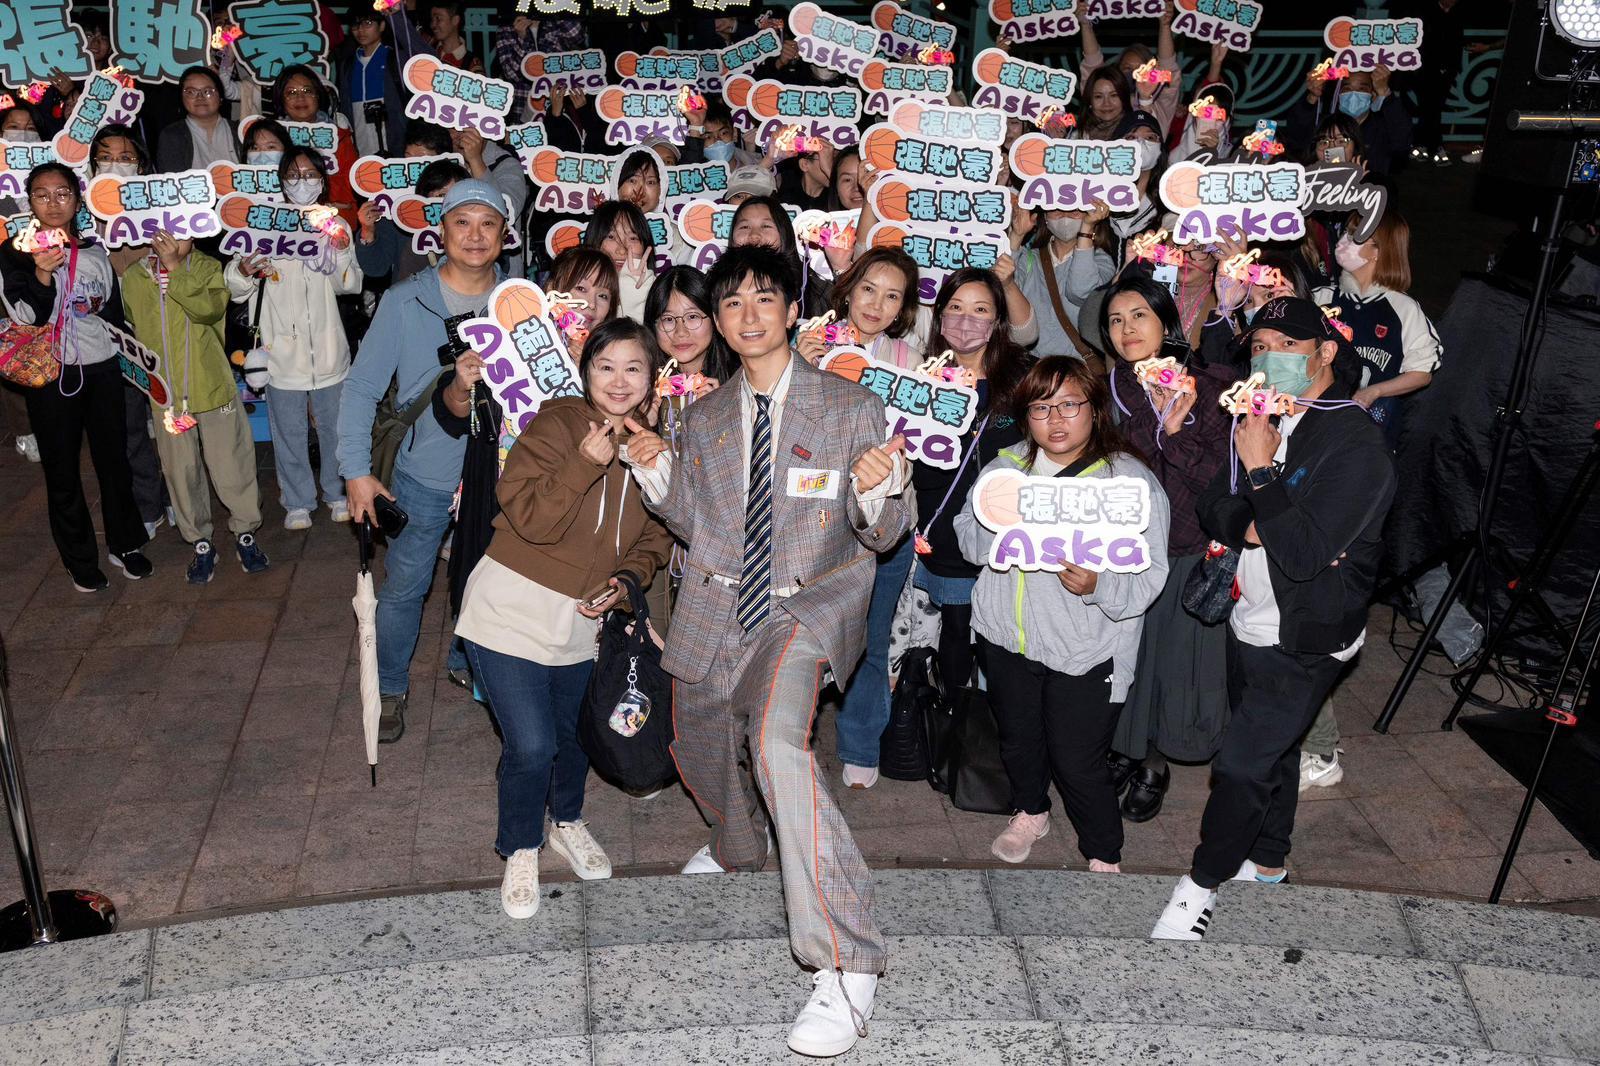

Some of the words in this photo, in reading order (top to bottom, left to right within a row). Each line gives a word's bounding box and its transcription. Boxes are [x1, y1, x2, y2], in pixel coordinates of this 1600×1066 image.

[811, 15, 877, 53] 張馳豪
[892, 14, 953, 48] 張馳豪
[1175, 13, 1248, 49] Aska
[1350, 22, 1419, 46] 張馳豪
[543, 51, 602, 74] 張馳豪
[635, 57, 698, 80] 張馳豪
[721, 32, 778, 69] 張馳豪
[432, 69, 508, 111] 張馳豪
[882, 67, 948, 93] 張馳豪
[1000, 62, 1072, 100] 張馳豪
[410, 94, 501, 136] Aska
[776, 89, 857, 119] 張馳豪
[919, 109, 1002, 142] 張馳豪
[893, 138, 994, 183] 張馳豪
[1043, 144, 1136, 176] 張馳豪
[119, 174, 210, 211] 張馳豪
[1023, 177, 1134, 206] Aska
[1197, 168, 1301, 205] 張馳豪
[906, 188, 1005, 224] 張馳豪
[1179, 208, 1300, 239] Aska
[224, 230, 319, 257] Aska
[1018, 483, 1146, 525] 張馳豪
[995, 528, 1145, 567] Aska
